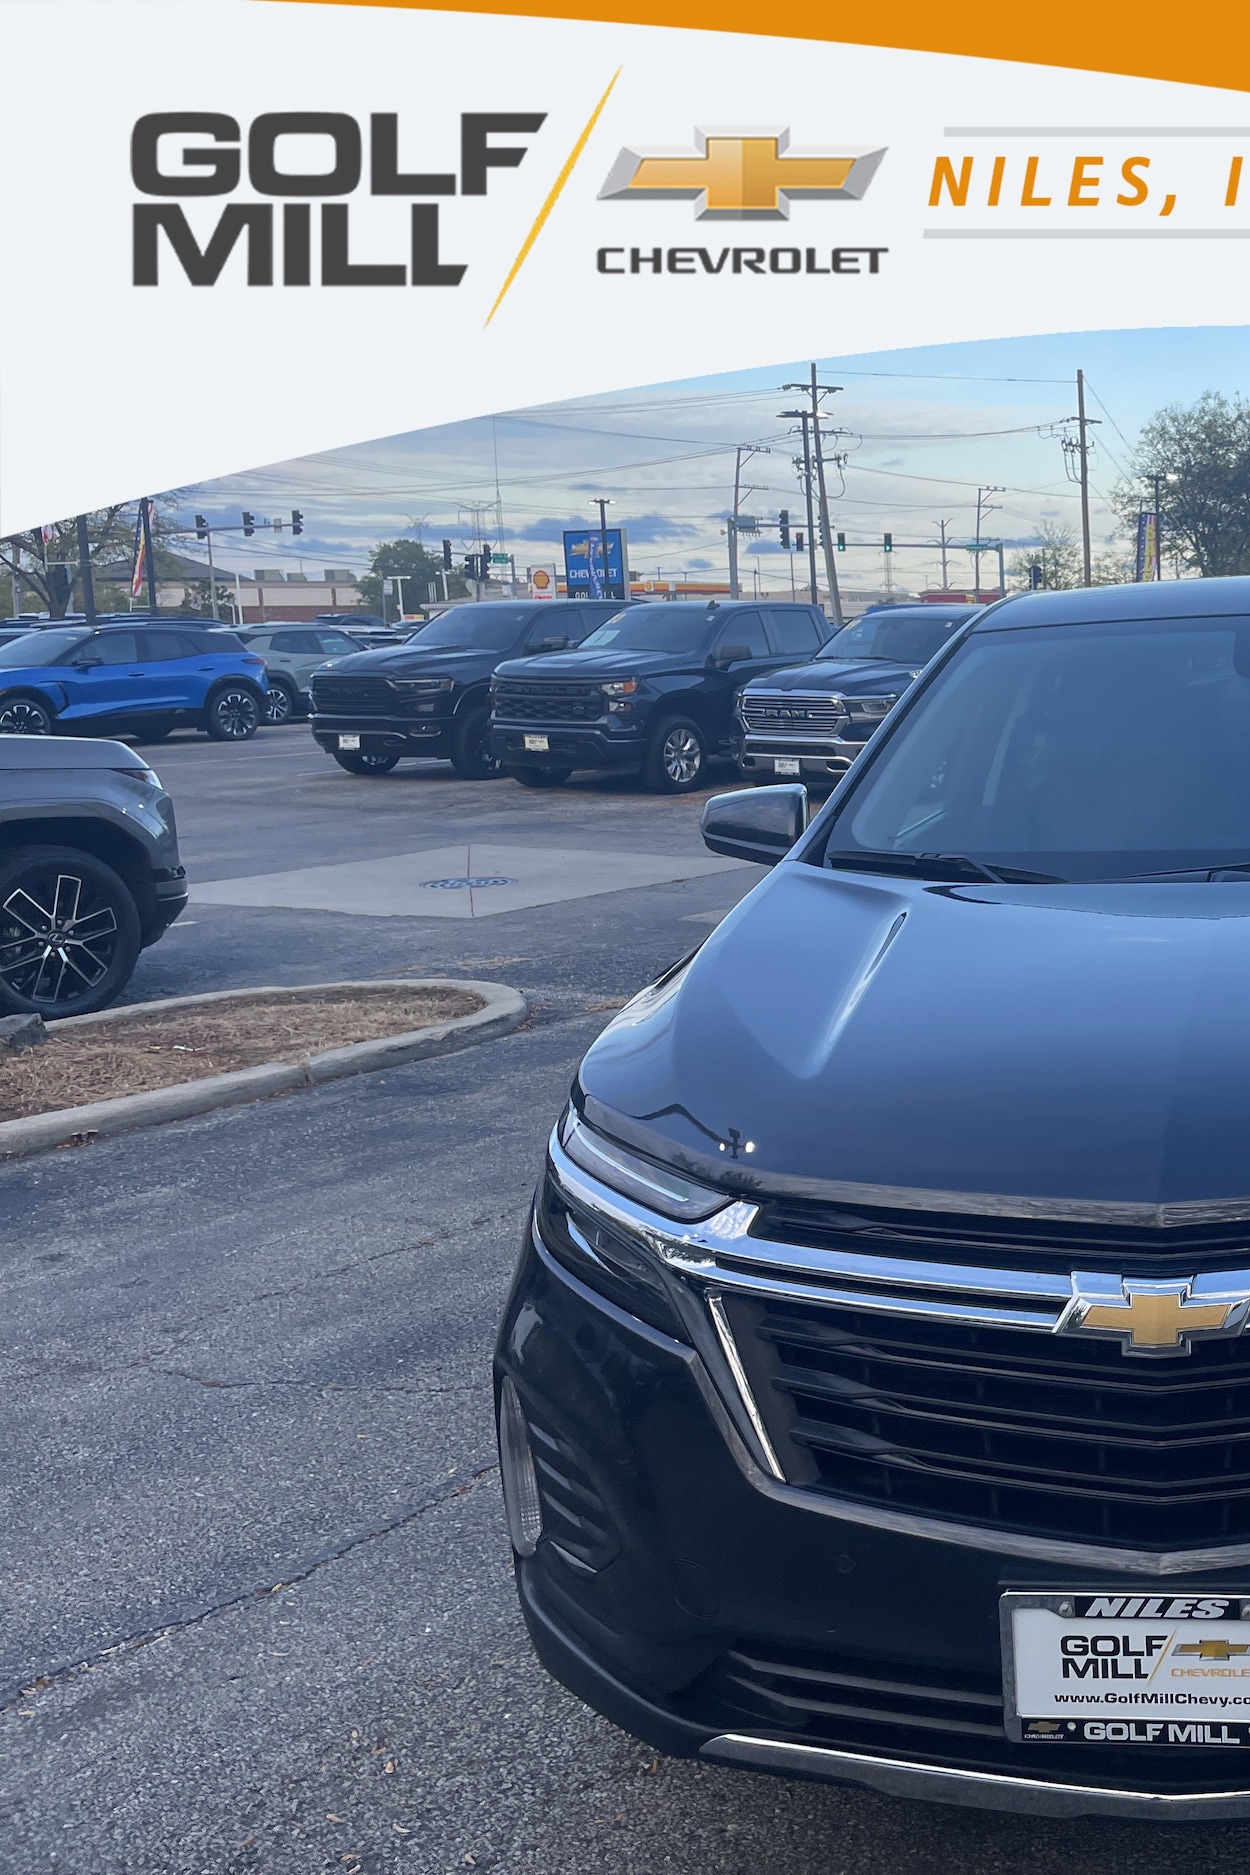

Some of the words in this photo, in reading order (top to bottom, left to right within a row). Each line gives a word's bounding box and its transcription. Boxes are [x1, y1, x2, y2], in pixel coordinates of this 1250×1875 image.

[1084, 1597, 1229, 1619] NILES
[1060, 1635, 1169, 1657] GOLF
[1062, 1658, 1150, 1680] MILL
[1083, 1722, 1164, 1742] GOLF
[1168, 1724, 1240, 1744] MILL
